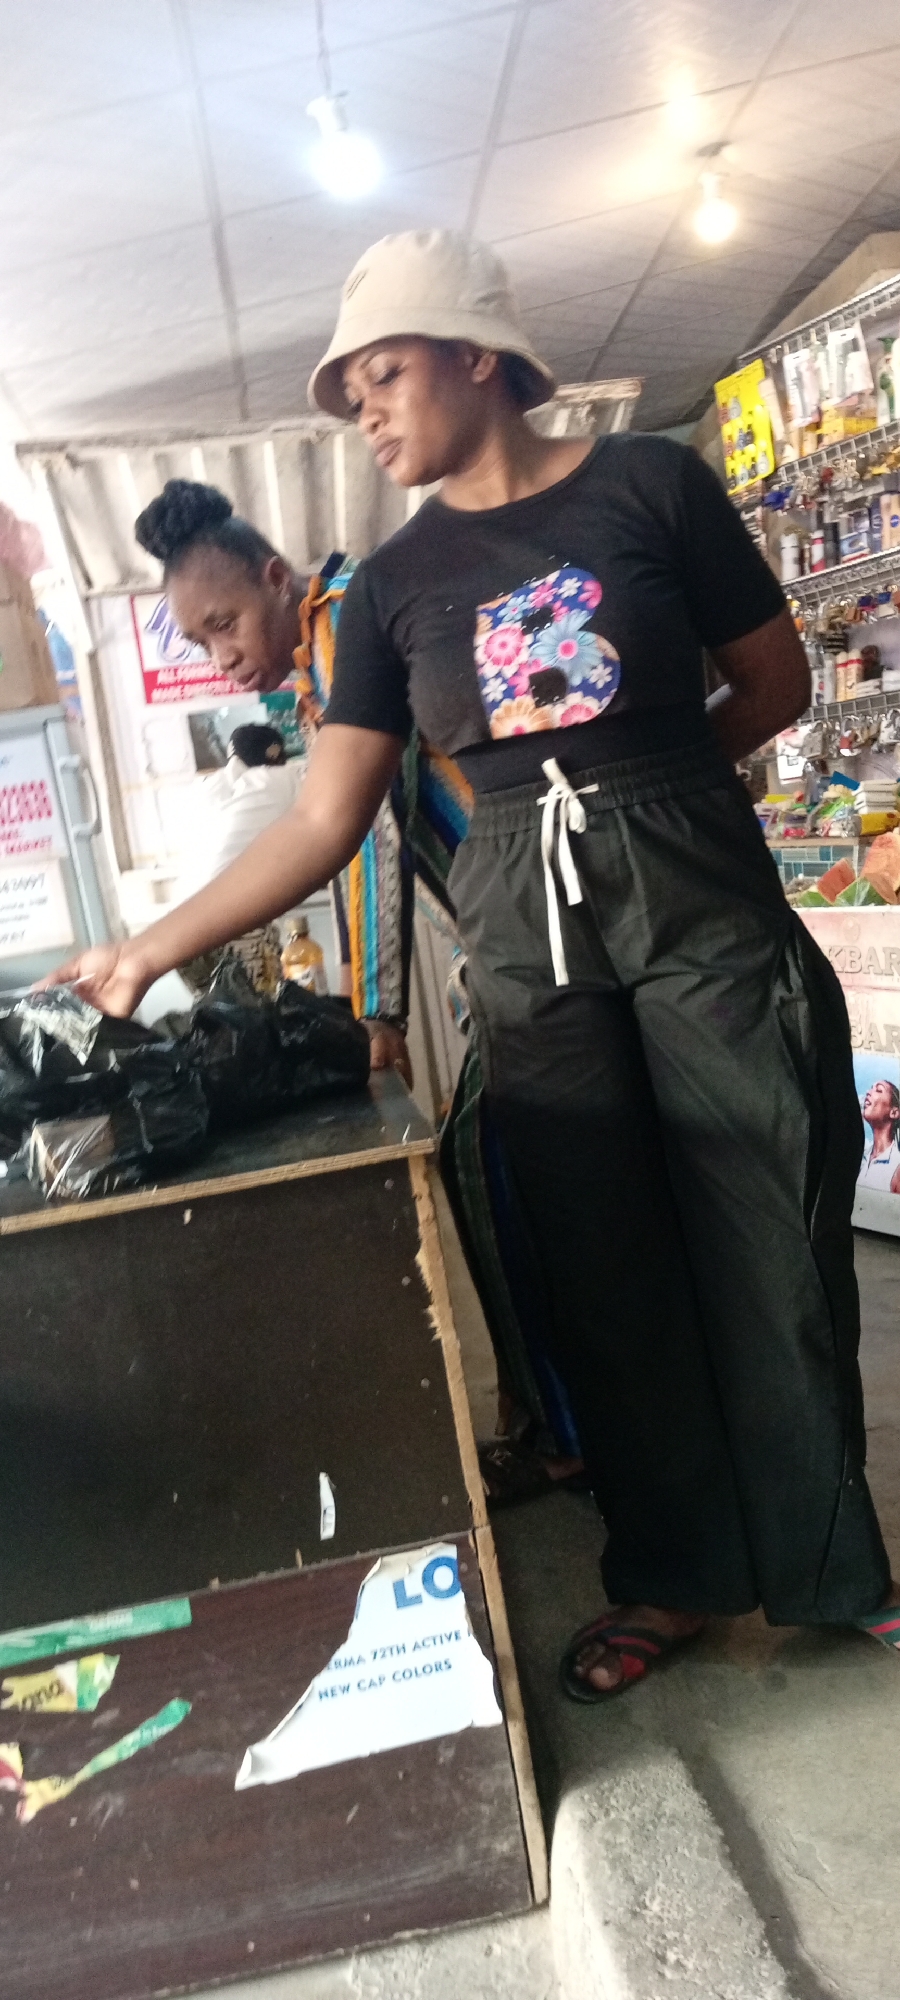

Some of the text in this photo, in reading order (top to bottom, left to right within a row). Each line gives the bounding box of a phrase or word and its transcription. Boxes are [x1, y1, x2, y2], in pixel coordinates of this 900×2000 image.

[473, 567, 621, 740] B
[392, 1556, 462, 1609] LO
[412, 1629, 462, 1652] ACTIVE
[318, 1657, 453, 1702] NEW CAP COLORS
